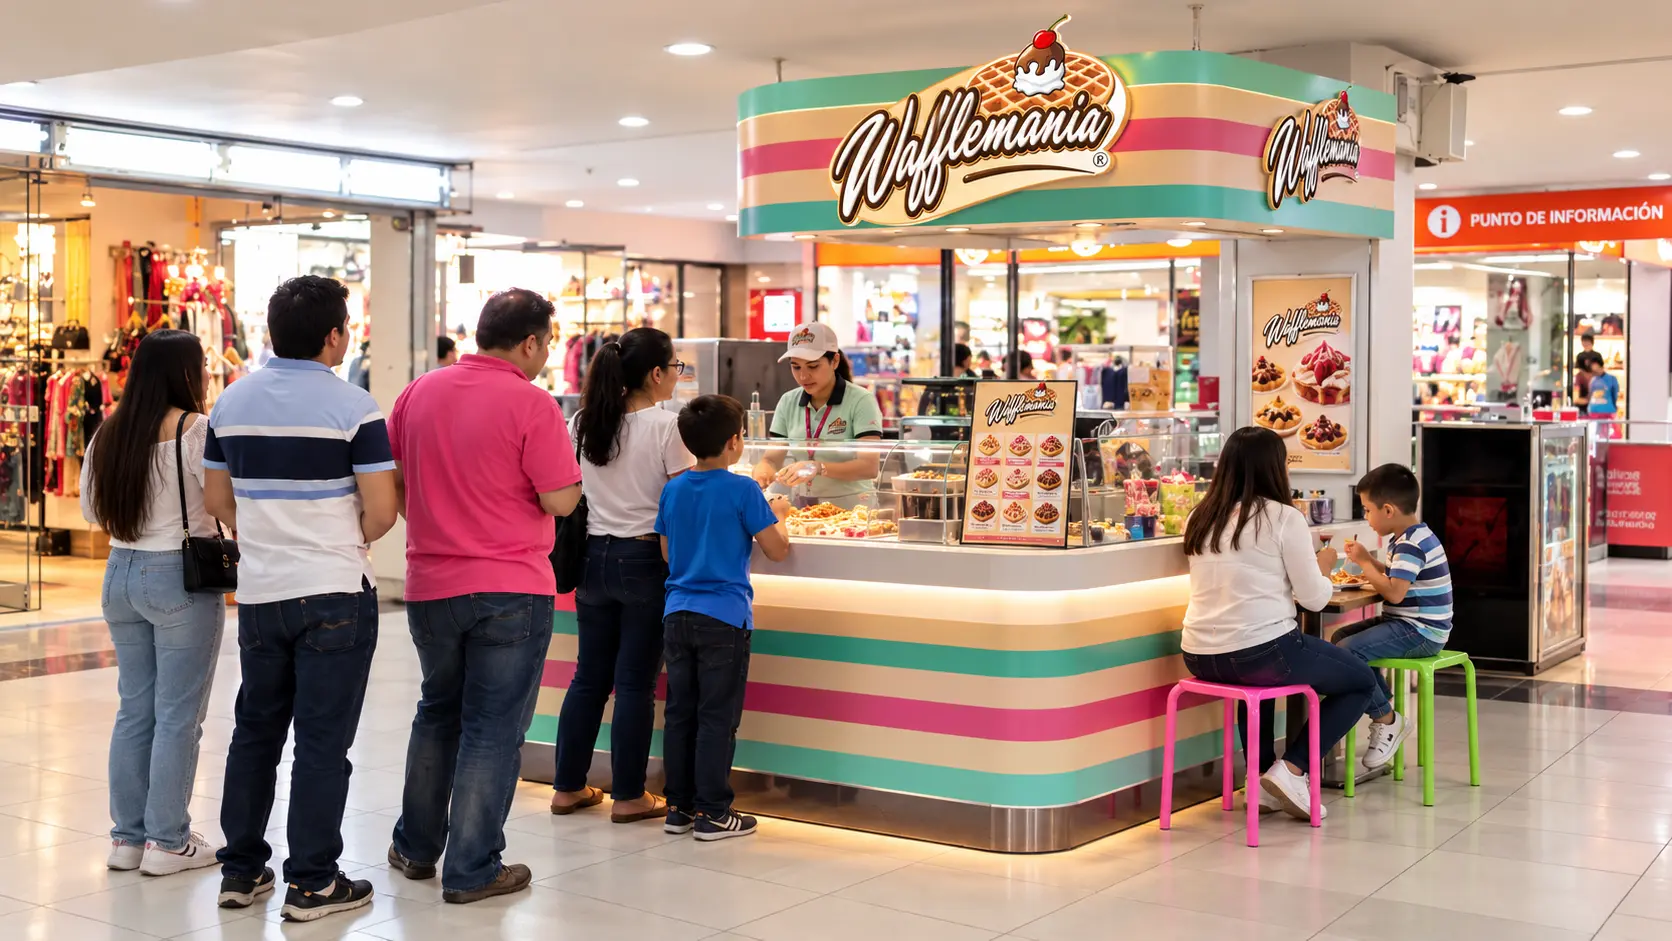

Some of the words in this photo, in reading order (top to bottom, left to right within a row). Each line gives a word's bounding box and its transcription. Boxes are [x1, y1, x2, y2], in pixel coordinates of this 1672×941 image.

[832, 87, 1113, 223] Wafflemania
[1267, 108, 1360, 209] Wafflemania
[1470, 212, 1522, 227] PUNTO
[1526, 210, 1546, 225] DE
[1550, 202, 1664, 224] INFORMACIÓN
